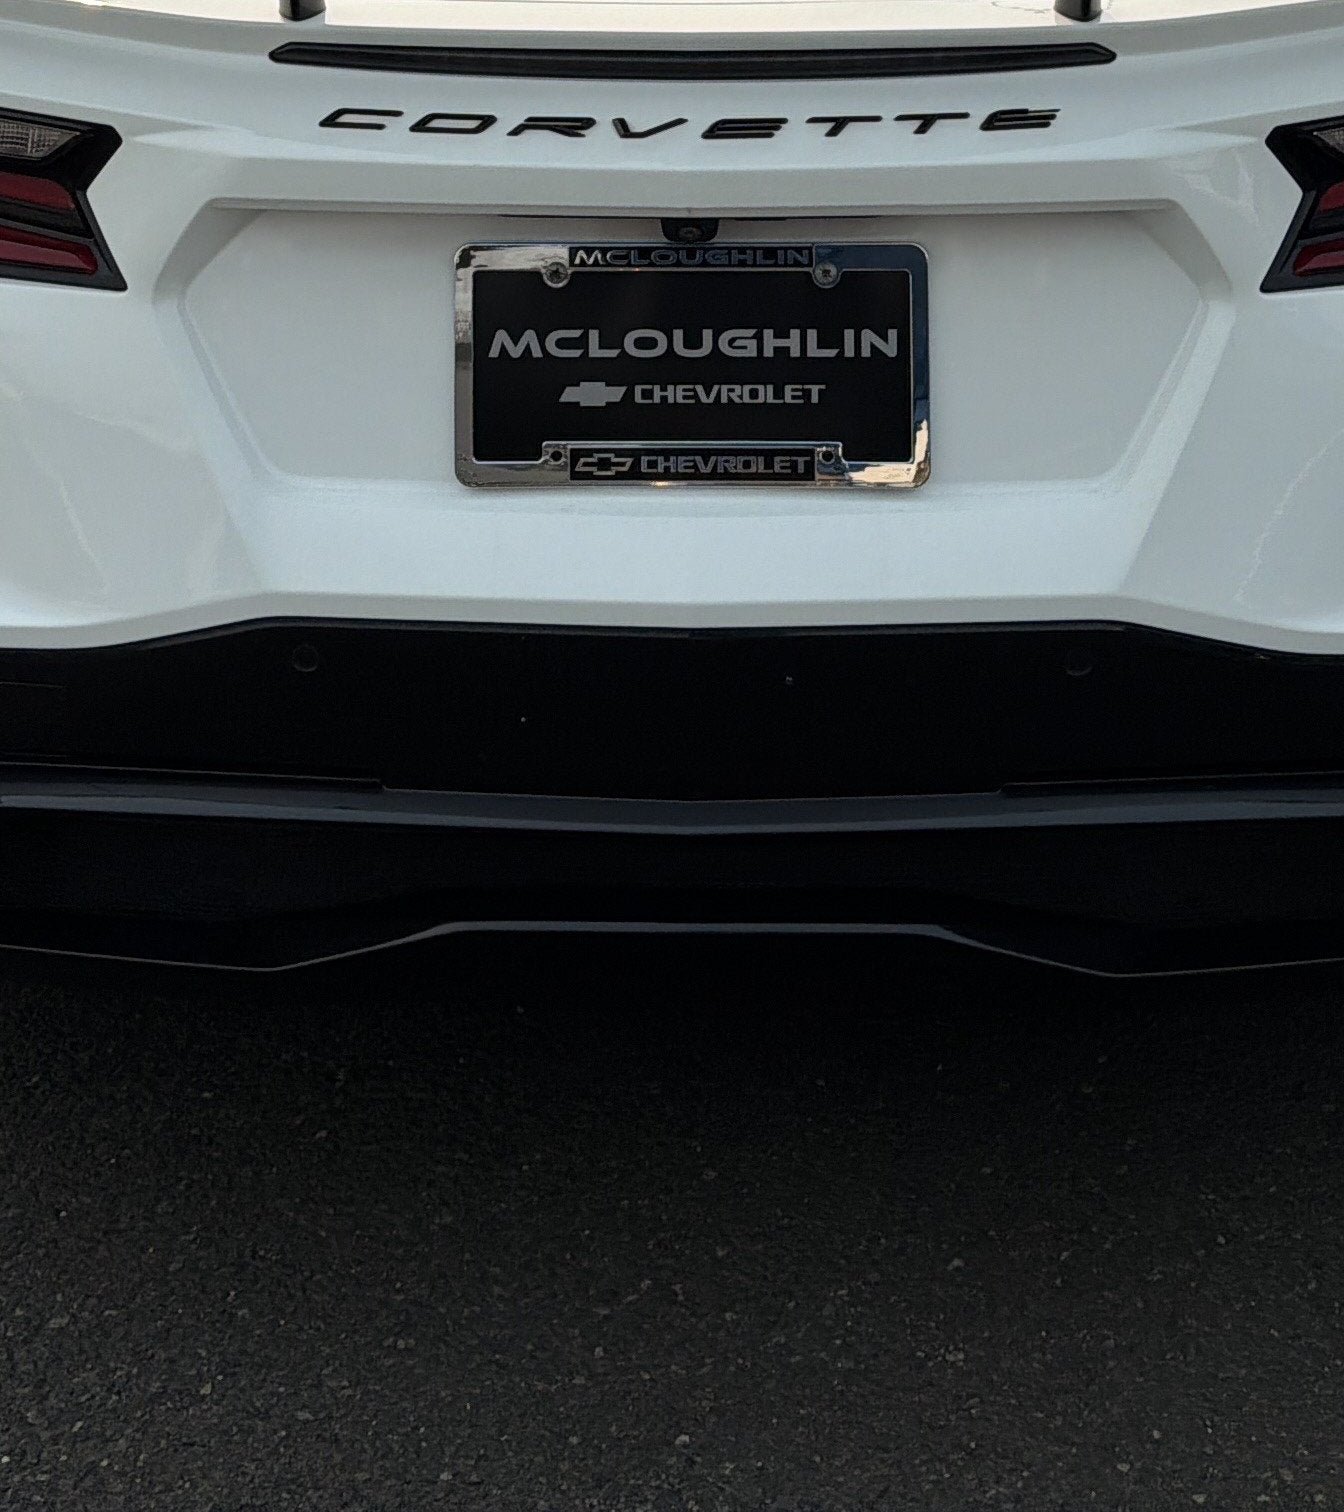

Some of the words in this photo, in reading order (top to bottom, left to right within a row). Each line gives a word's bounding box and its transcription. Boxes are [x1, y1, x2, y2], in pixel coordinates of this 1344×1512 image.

[319, 107, 1060, 139] CORVETTE
[574, 249, 810, 266] MCLOUGHLIN
[488, 328, 898, 358] MCLOUGHLIN
[634, 384, 826, 404] CHEVROLET
[640, 455, 811, 473] CHEVROLET
